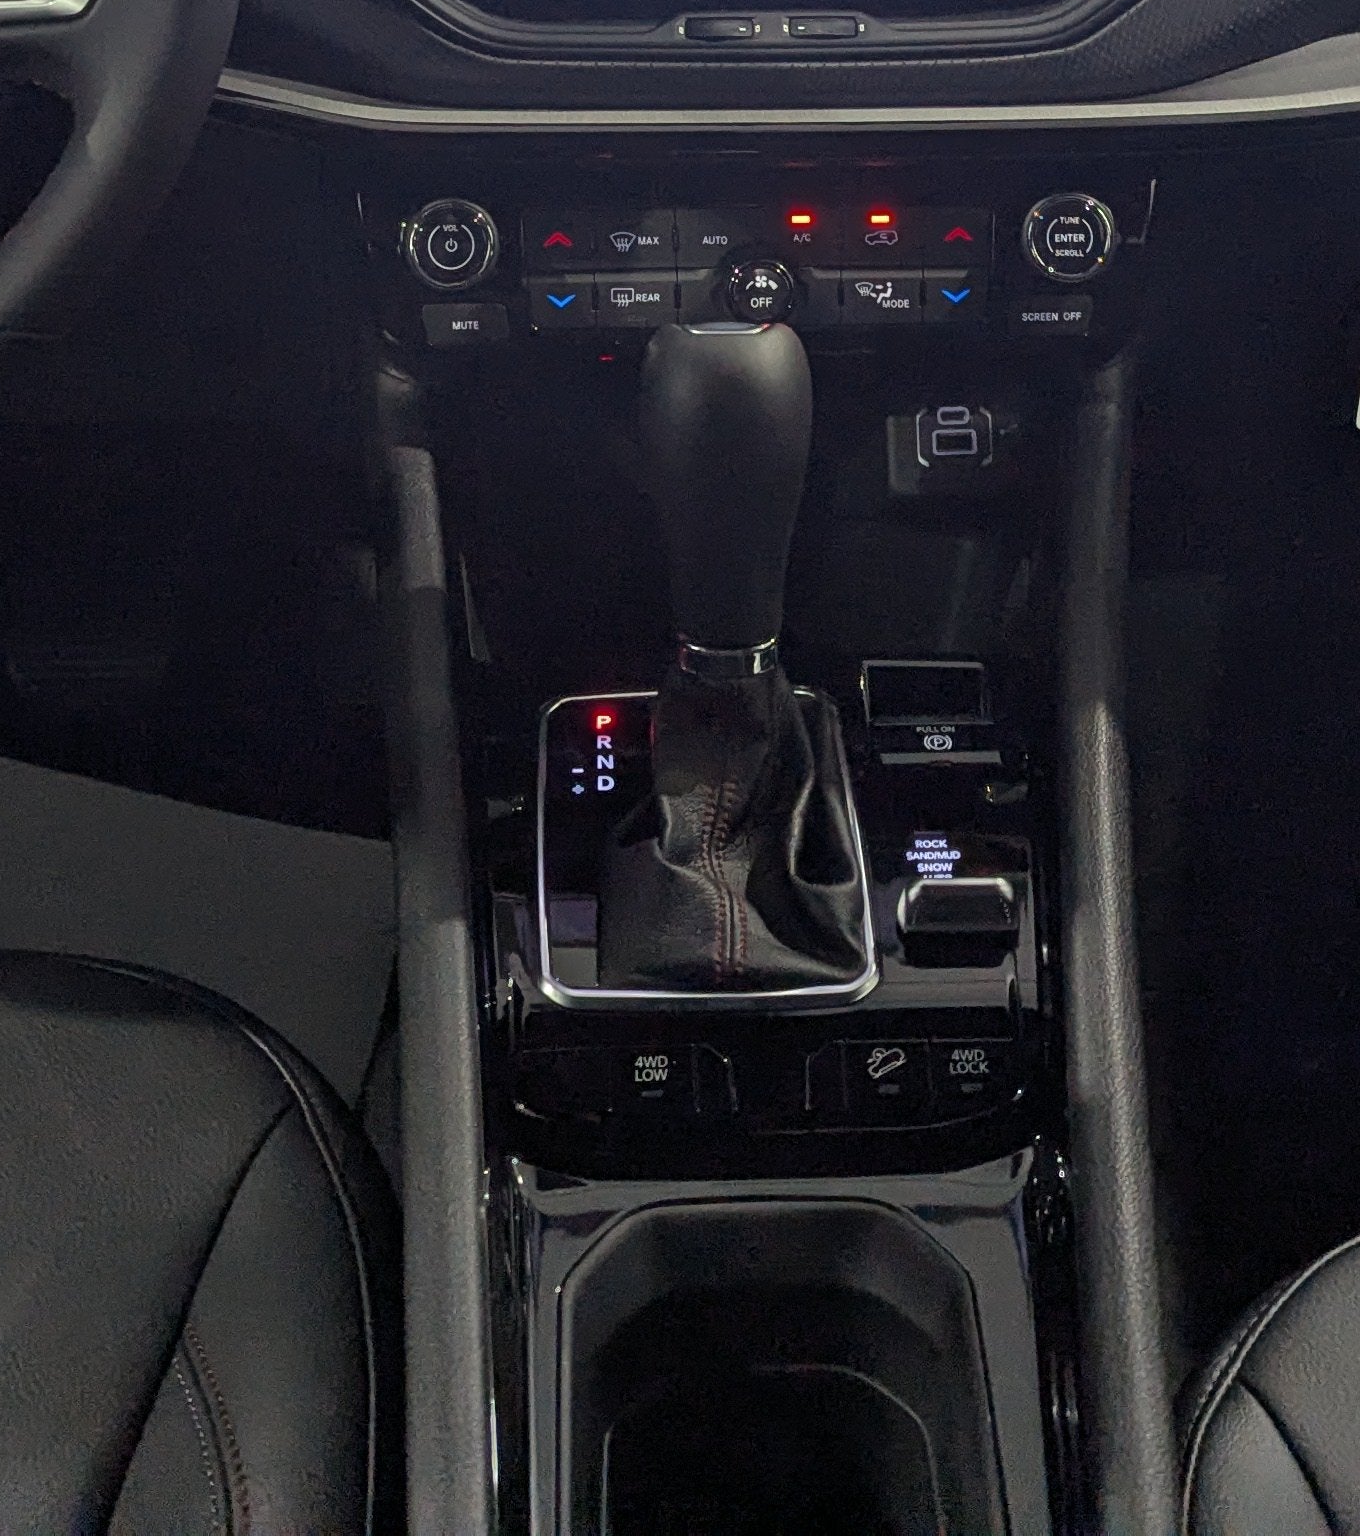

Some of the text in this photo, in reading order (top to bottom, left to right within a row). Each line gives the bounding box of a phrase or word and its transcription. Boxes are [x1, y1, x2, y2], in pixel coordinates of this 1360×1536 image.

[1059, 216, 1080, 225] TUNE
[442, 224, 459, 232] VOL
[637, 236, 660, 246] MAX
[702, 235, 728, 245] AUTO
[793, 233, 811, 243] A/C
[1054, 233, 1085, 243] ENTER
[1054, 248, 1085, 257] SCROLL
[635, 293, 660, 303] REAR
[750, 297, 773, 309] OFF
[882, 299, 910, 309] MODE
[1021, 312, 1082, 322] SCREEN OFF
[452, 321, 479, 331] MUTE
[596, 715, 612, 729] P
[916, 725, 955, 733] PULL ON
[596, 735, 612, 749] R
[596, 754, 615, 770] N
[597, 775, 615, 791] D
[915, 839, 948, 849] ROCK
[906, 851, 961, 861] SAND/MUD
[916, 862, 953, 873] SNOW
[950, 1049, 985, 1062] 4WD
[634, 1055, 669, 1068] 4WD
[949, 1062, 990, 1075] LOCK
[634, 1069, 669, 1082] LOW
